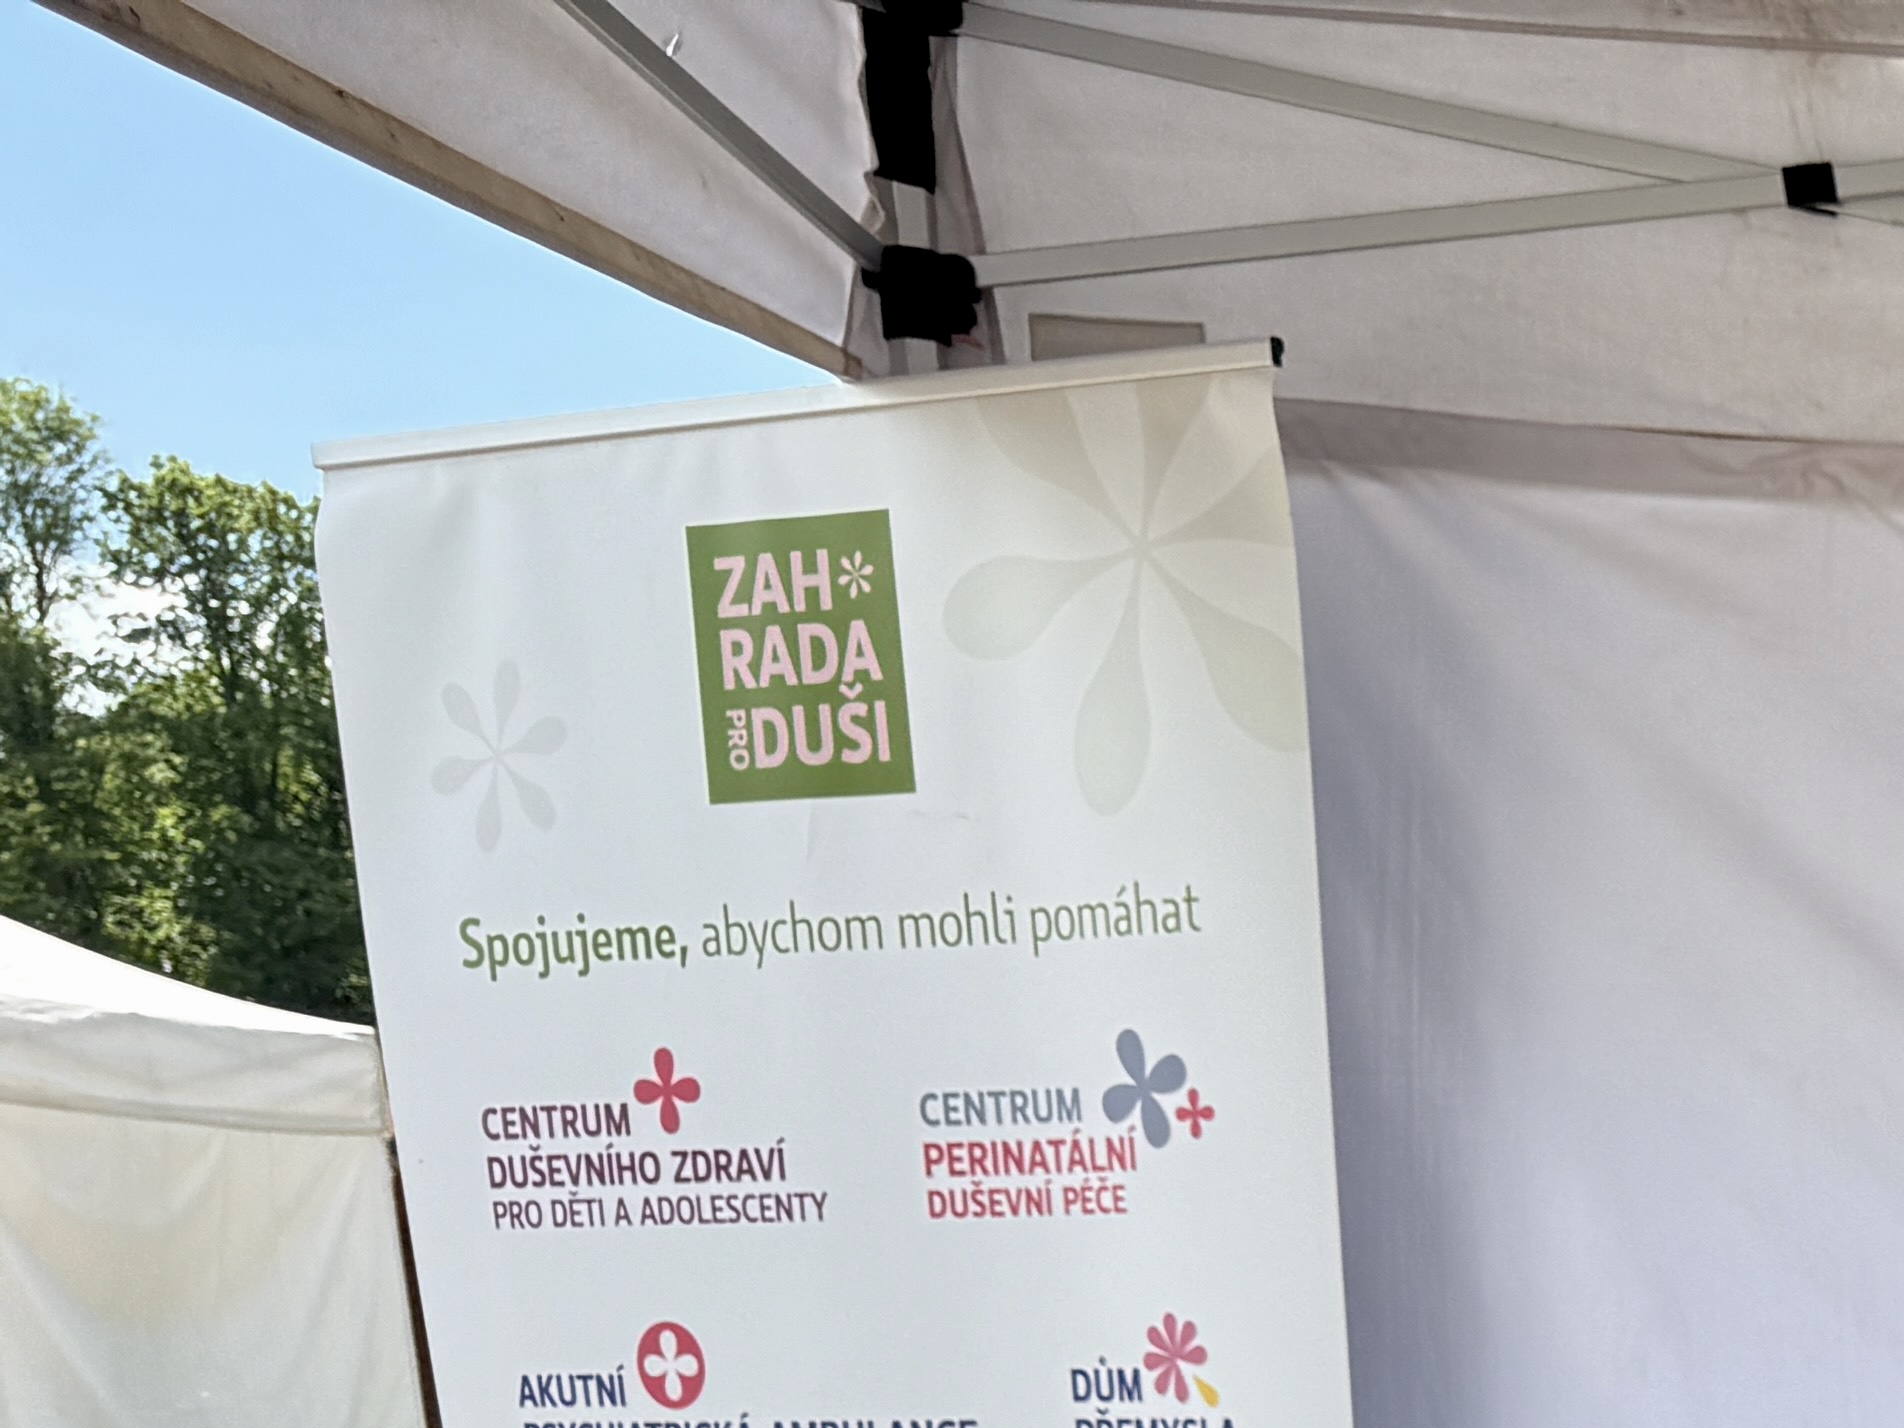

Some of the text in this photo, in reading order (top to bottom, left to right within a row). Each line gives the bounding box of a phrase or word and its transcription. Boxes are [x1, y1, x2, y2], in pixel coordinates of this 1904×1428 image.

[713, 548, 832, 619] ZAH
[719, 619, 882, 691] RADA
[726, 681, 892, 770] PRO DUŠI
[459, 880, 1201, 982] Spojujeme, abychom mohli pomáhat
[481, 1103, 631, 1141] CENTRUM
[919, 1087, 1082, 1128] CENTRUM
[487, 1138, 787, 1190] DUŠEVNÍHO ZDRAVÍ
[922, 1127, 1138, 1178] PERINATÁLNÍ
[492, 1188, 828, 1231] PRO DĚTI A ADOLESCENTY
[926, 1174, 1127, 1220] DUŠEVNÍ PÉČE
[518, 1366, 627, 1409] AKUTNÍ
[1070, 1355, 1144, 1404] DŮM
